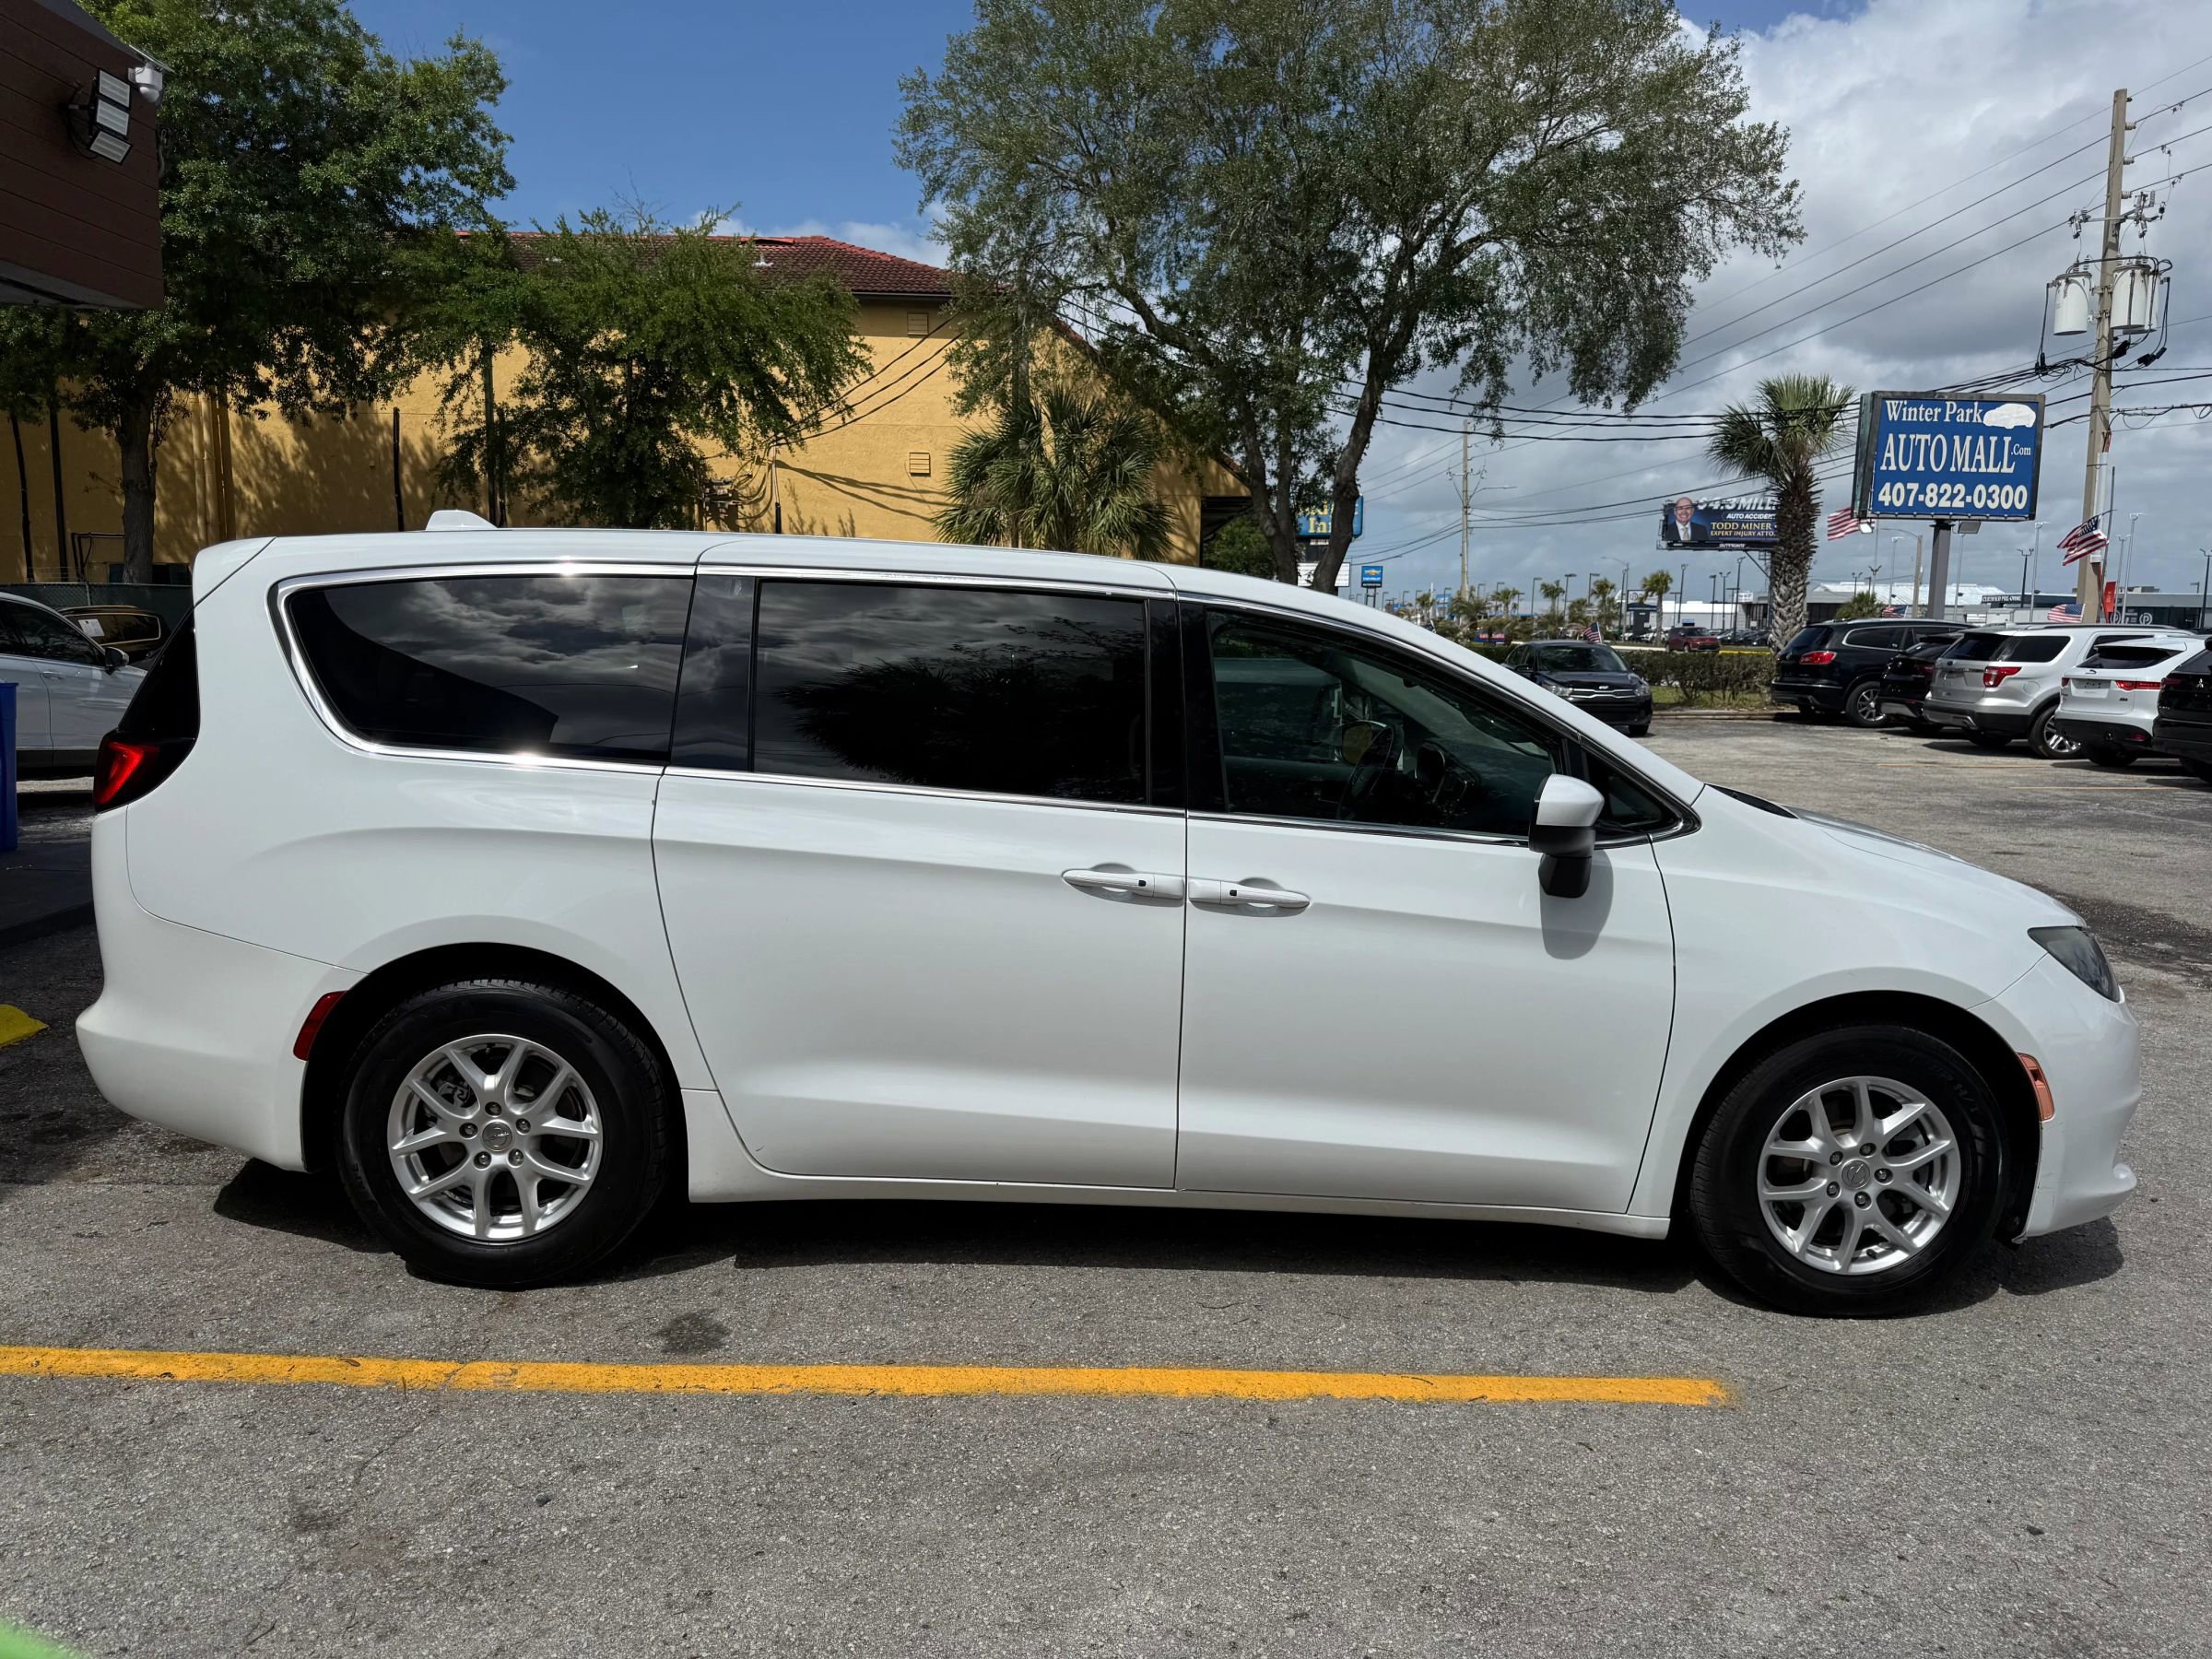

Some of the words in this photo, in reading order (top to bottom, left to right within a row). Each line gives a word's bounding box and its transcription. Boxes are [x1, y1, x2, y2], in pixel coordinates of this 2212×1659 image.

[1886, 400, 1939, 422] Winter
[1944, 401, 1984, 423] Park
[1880, 433, 1947, 472] AUTO
[1950, 435, 2016, 474] MALL
[1877, 482, 2028, 510] 407-822-0300
[1711, 522, 1739, 530] TODD
[1741, 522, 1771, 530] MINER
